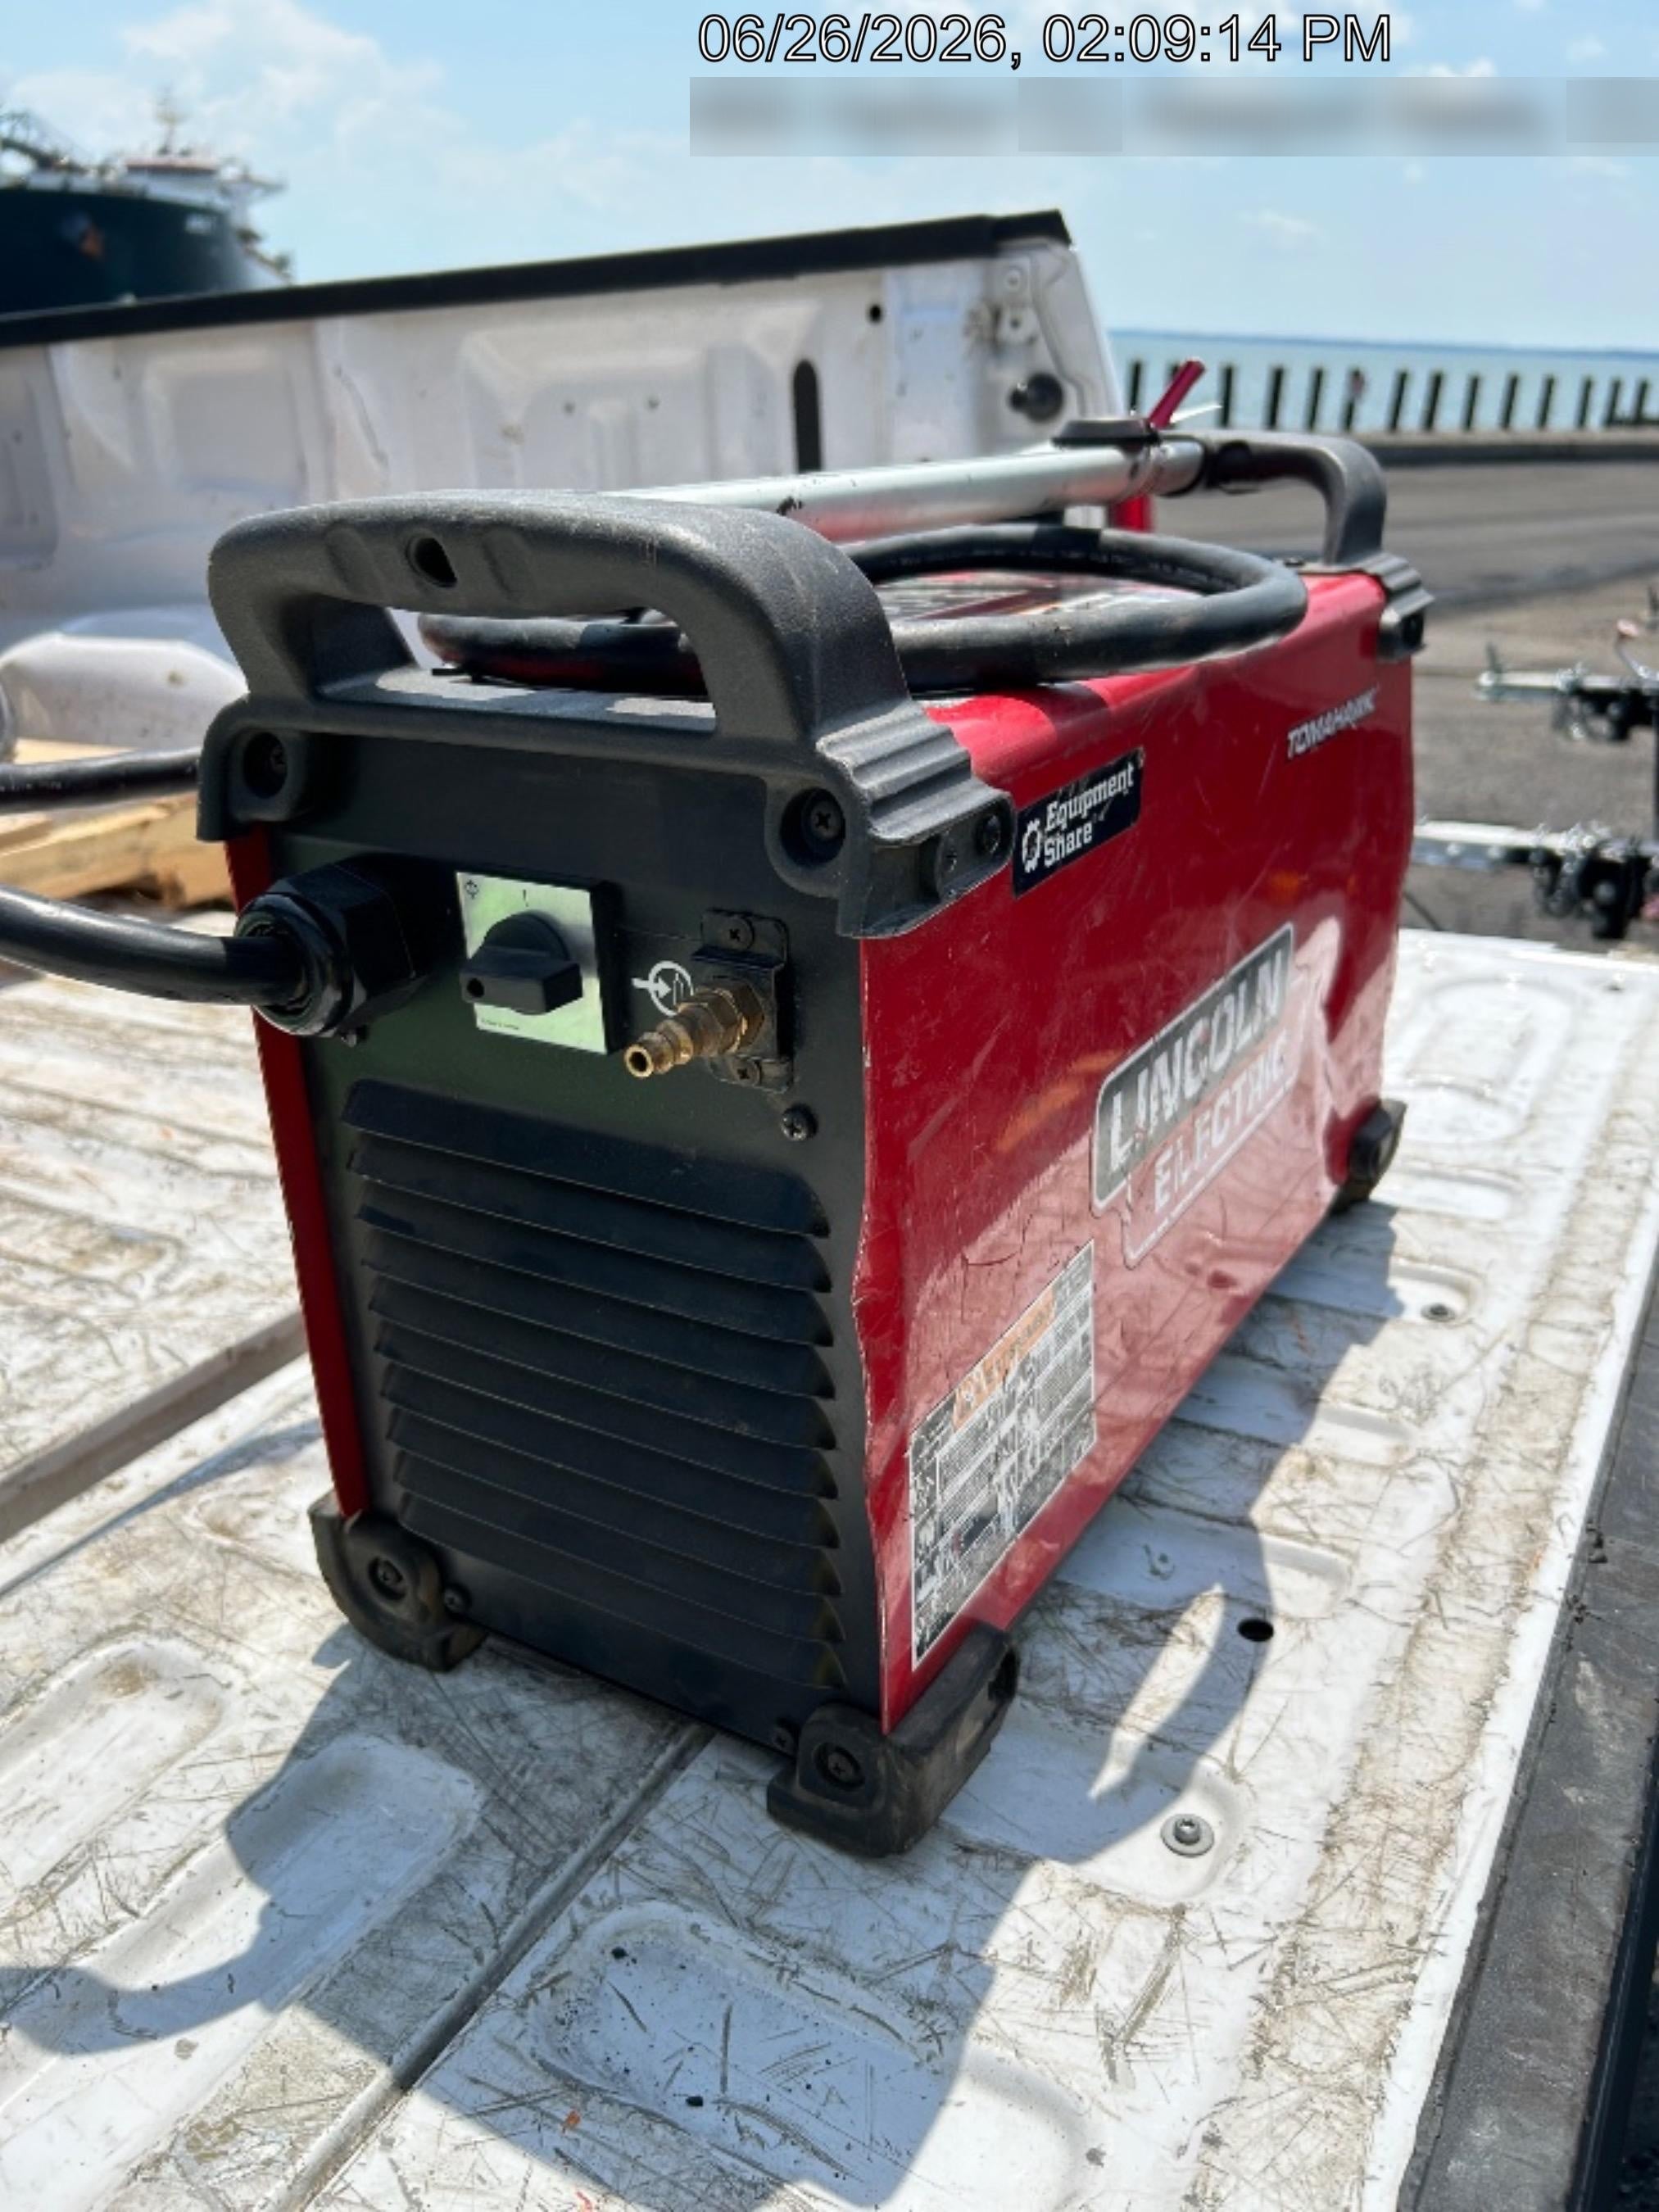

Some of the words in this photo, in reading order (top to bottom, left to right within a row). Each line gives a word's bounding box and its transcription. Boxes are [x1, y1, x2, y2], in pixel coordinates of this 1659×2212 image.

[1045, 762, 1134, 831] Equipment
[1044, 822, 1093, 868] Share
[1109, 949, 1282, 1175] LINCOLN
